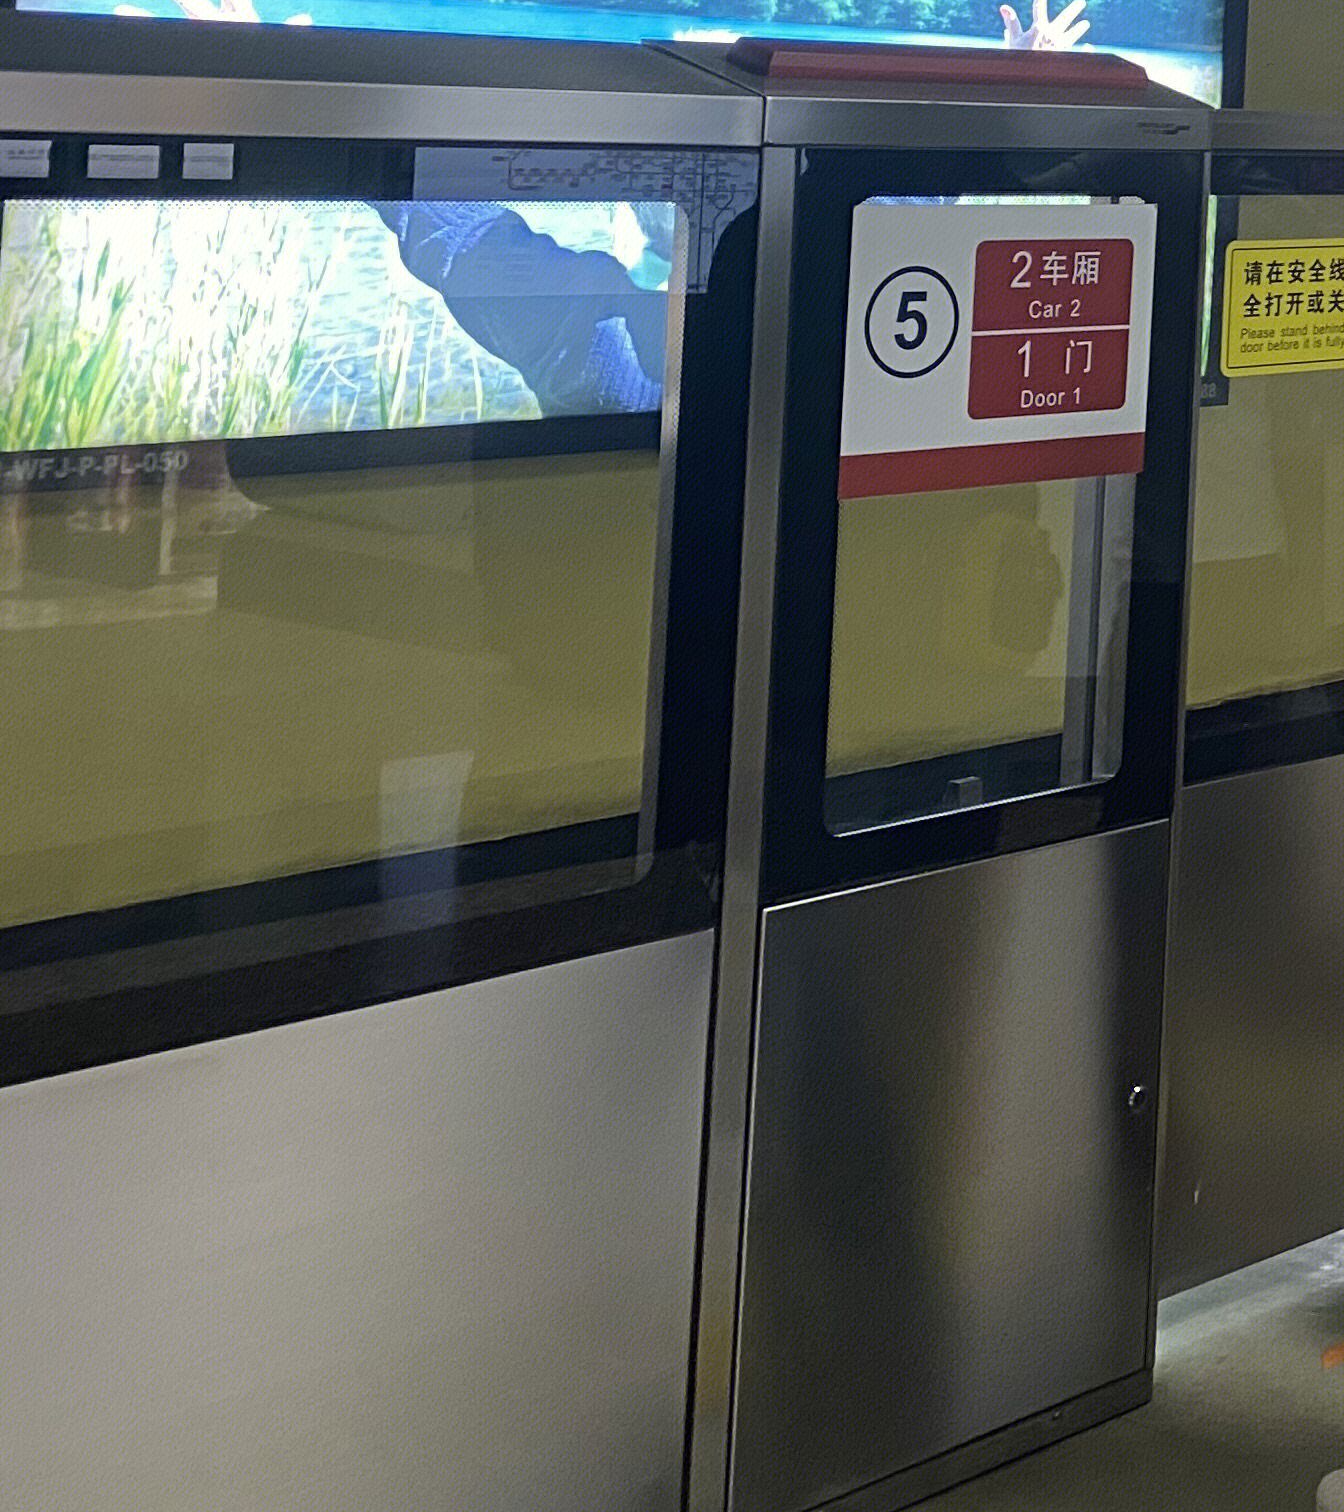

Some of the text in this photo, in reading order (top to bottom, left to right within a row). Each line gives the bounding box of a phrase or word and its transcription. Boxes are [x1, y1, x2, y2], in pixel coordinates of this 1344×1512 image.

[1028, 299, 1081, 319] Car 2
[893, 291, 928, 350] 5
[1240, 328, 1277, 339] Please
[1281, 326, 1308, 337] stand
[1313, 322, 1344, 336] behind
[1240, 341, 1263, 353] door
[1267, 338, 1300, 351] before
[1325, 335, 1344, 348] fully
[1017, 339, 1093, 378] 1 门
[1020, 387, 1081, 409] Door 1
